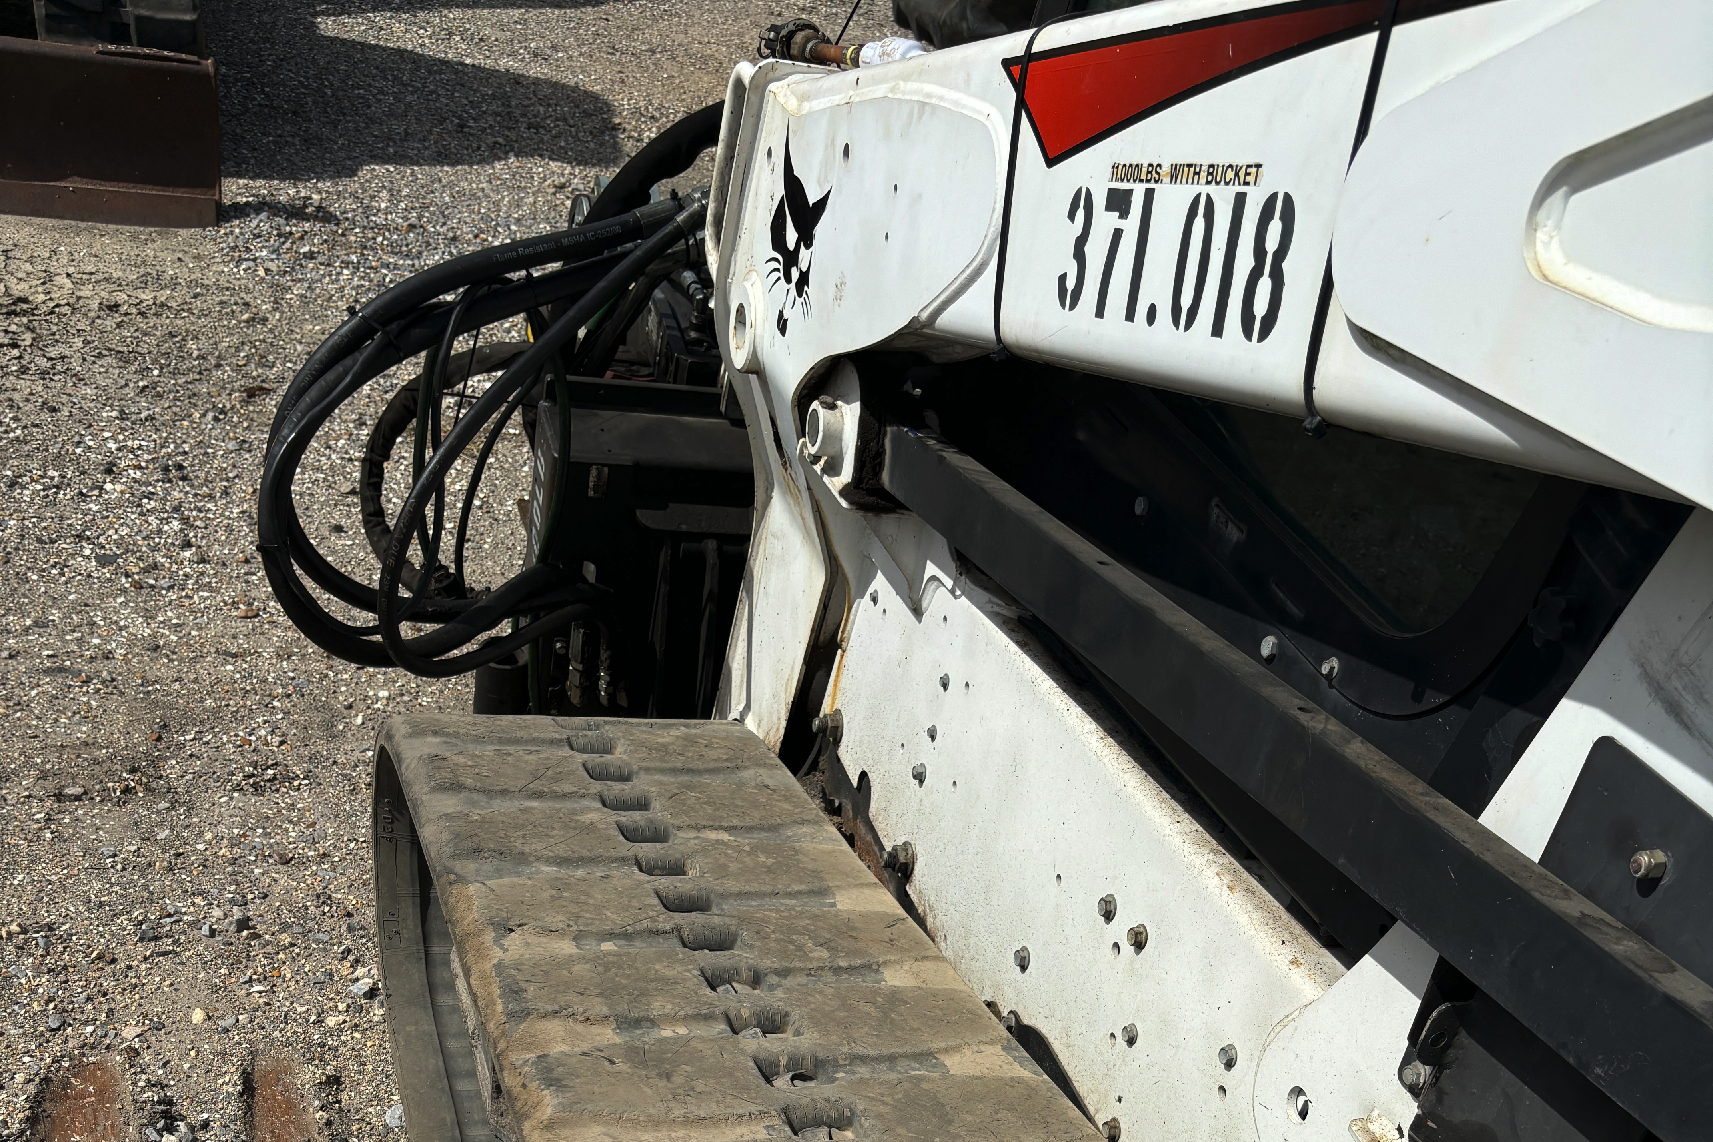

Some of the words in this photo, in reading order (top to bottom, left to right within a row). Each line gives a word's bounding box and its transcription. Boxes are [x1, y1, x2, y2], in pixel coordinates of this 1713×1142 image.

[1169, 163, 1203, 185] WITH
[1205, 163, 1263, 187] BUCKET
[492, 250, 517, 263] Flame
[518, 240, 557, 256] Resistant
[561, 234, 587, 247] MSHA
[1057, 186, 1296, 343] 371.018
